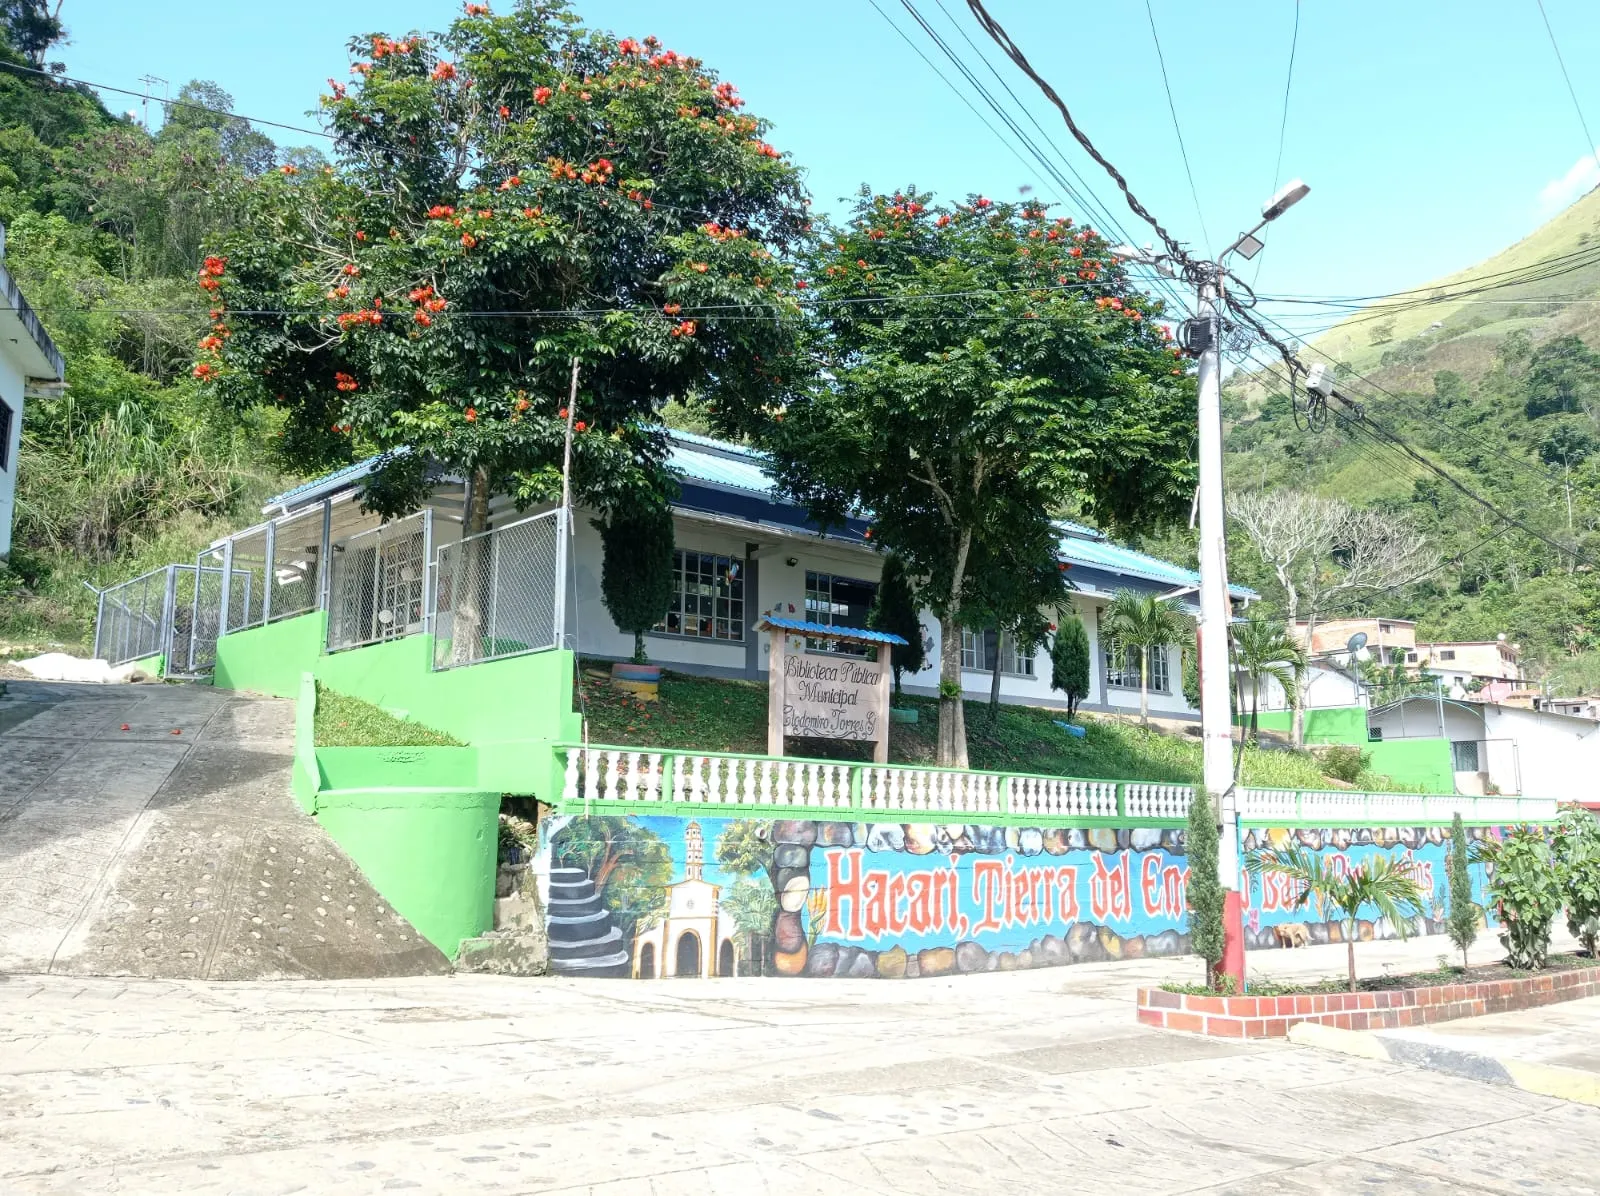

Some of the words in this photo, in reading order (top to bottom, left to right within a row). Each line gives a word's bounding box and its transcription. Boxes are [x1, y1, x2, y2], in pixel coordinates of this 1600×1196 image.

[784, 655, 838, 682] Biblioteca
[840, 661, 879, 686] Pública
[798, 680, 859, 708] Municipal
[831, 708, 864, 733] Torres
[973, 856, 1079, 935] Tierra
[1090, 850, 1131, 922] del
